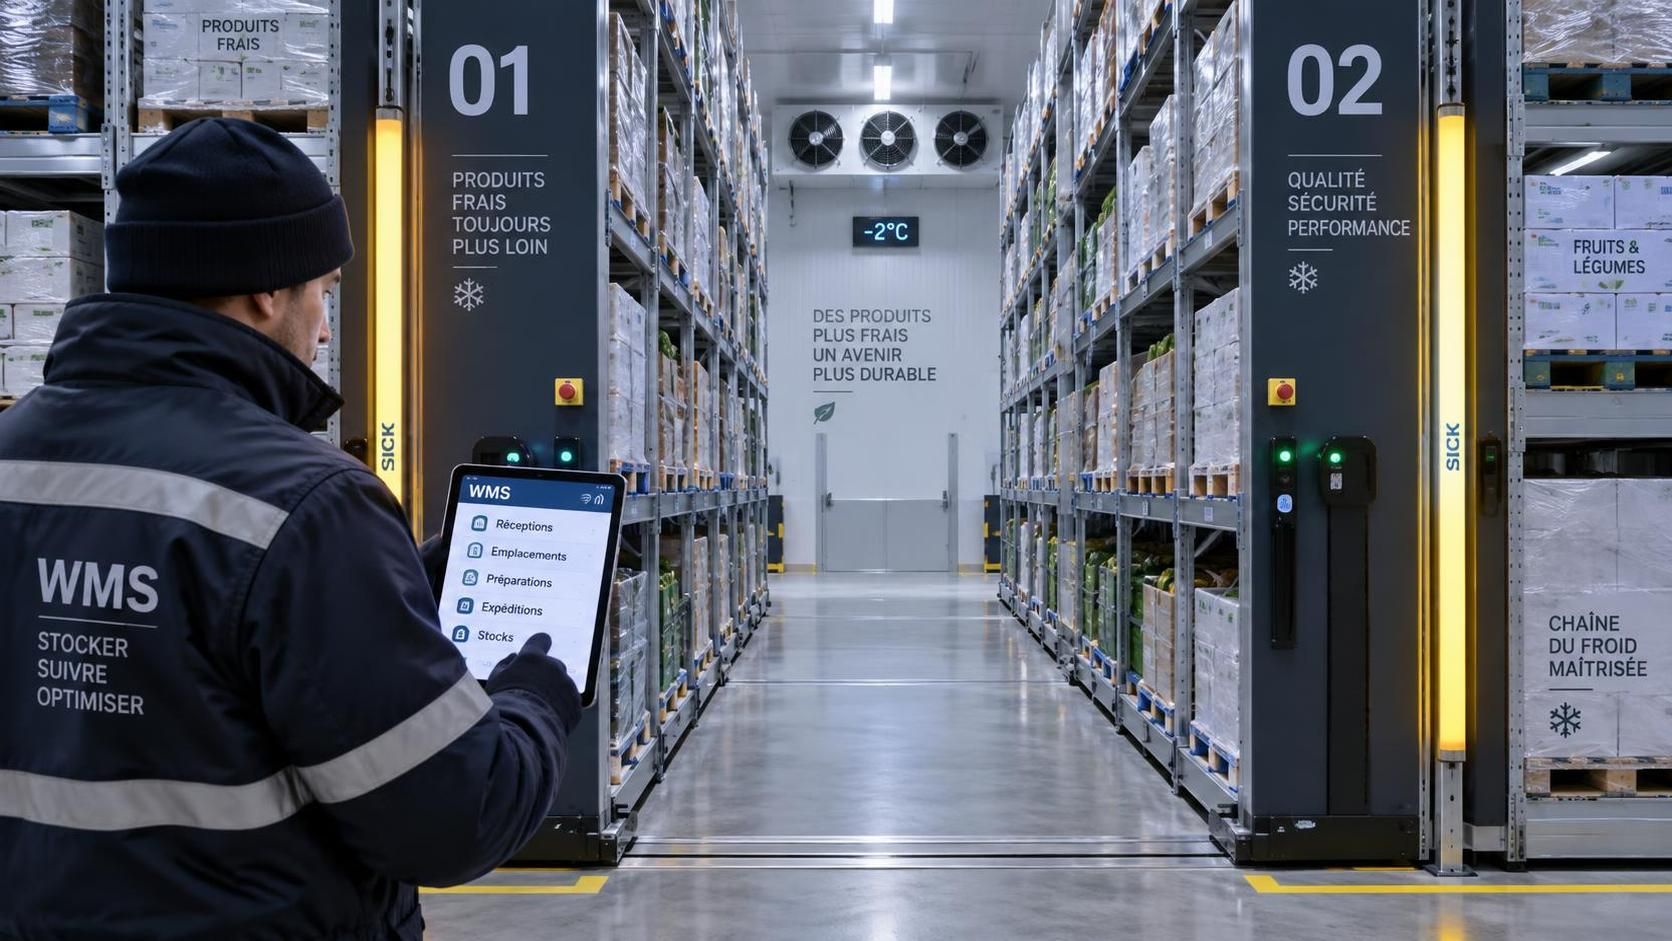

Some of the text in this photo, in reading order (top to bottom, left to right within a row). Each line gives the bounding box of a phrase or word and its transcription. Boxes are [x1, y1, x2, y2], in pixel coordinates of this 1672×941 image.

[202, 19, 279, 33] PRODUITS
[217, 37, 260, 52] FRAIS
[450, 44, 528, 116] 01
[1288, 44, 1382, 116] 02
[452, 171, 545, 188] PRODUITS
[1288, 168, 1366, 190] QUALITÉ
[452, 193, 507, 211] FRAIS
[1288, 191, 1377, 212] SÉCURITÉ
[452, 216, 551, 233] TOUJOURS
[864, 222, 909, 241] -2°C
[1288, 219, 1411, 236] PERFORMANCE
[453, 238, 548, 255] PLUS LOIN
[1573, 239, 1625, 255] FRUITS
[1628, 240, 1640, 254] &
[1573, 256, 1646, 275] LÉGUMES
[813, 308, 932, 324] DES PRODUITS
[813, 328, 909, 343] PLUS FRAIS
[813, 347, 902, 362] UN AVENIR
[813, 366, 937, 382] PLUS DURABLE
[381, 422, 395, 472] SICK
[1445, 423, 1460, 472] SICK
[469, 483, 511, 500] WMS
[495, 518, 553, 533] Réceptions
[490, 546, 567, 562] Emplacements
[37, 557, 159, 613] WMS
[486, 573, 553, 588] Préparations
[481, 601, 543, 616] Expéditions
[1548, 611, 1620, 632] CHAÎNE
[37, 630, 129, 658] STOCKER
[477, 630, 514, 643] Stocks
[1549, 637, 1637, 655] DU FROID
[37, 658, 107, 684] SUIVRE
[1549, 656, 1648, 677] MAÎTRISÉE
[36, 686, 144, 715] OPTIMISER
